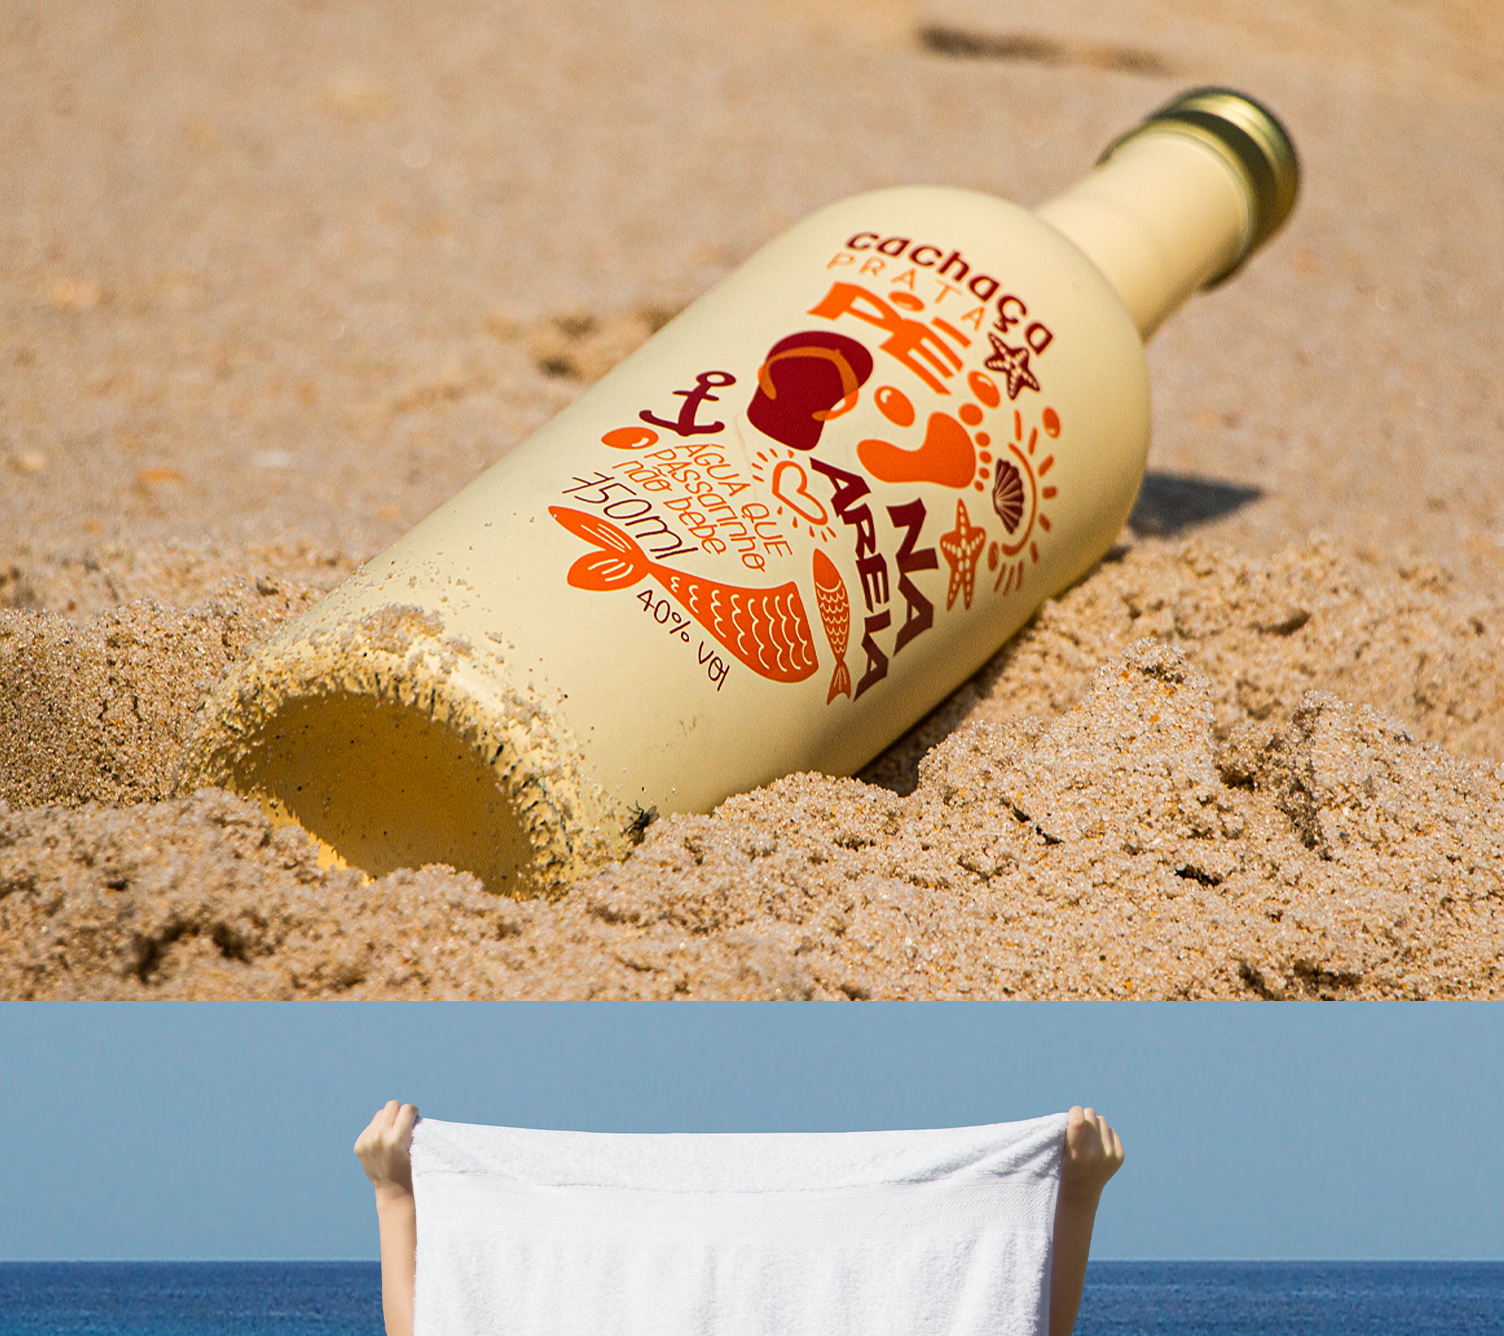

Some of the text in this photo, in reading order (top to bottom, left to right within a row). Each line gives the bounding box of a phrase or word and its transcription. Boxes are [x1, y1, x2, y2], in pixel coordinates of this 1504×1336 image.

[807, 281, 972, 396] PÉ
[826, 252, 986, 332] PRATA
[845, 232, 1053, 355] cachaça
[562, 471, 699, 560] 750ml
[611, 460, 727, 555] não bebe
[674, 443, 793, 557] ÁGUA QUE
[636, 589, 691, 643] 40%
[809, 456, 892, 703] AREIA
[886, 497, 939, 657] NA
